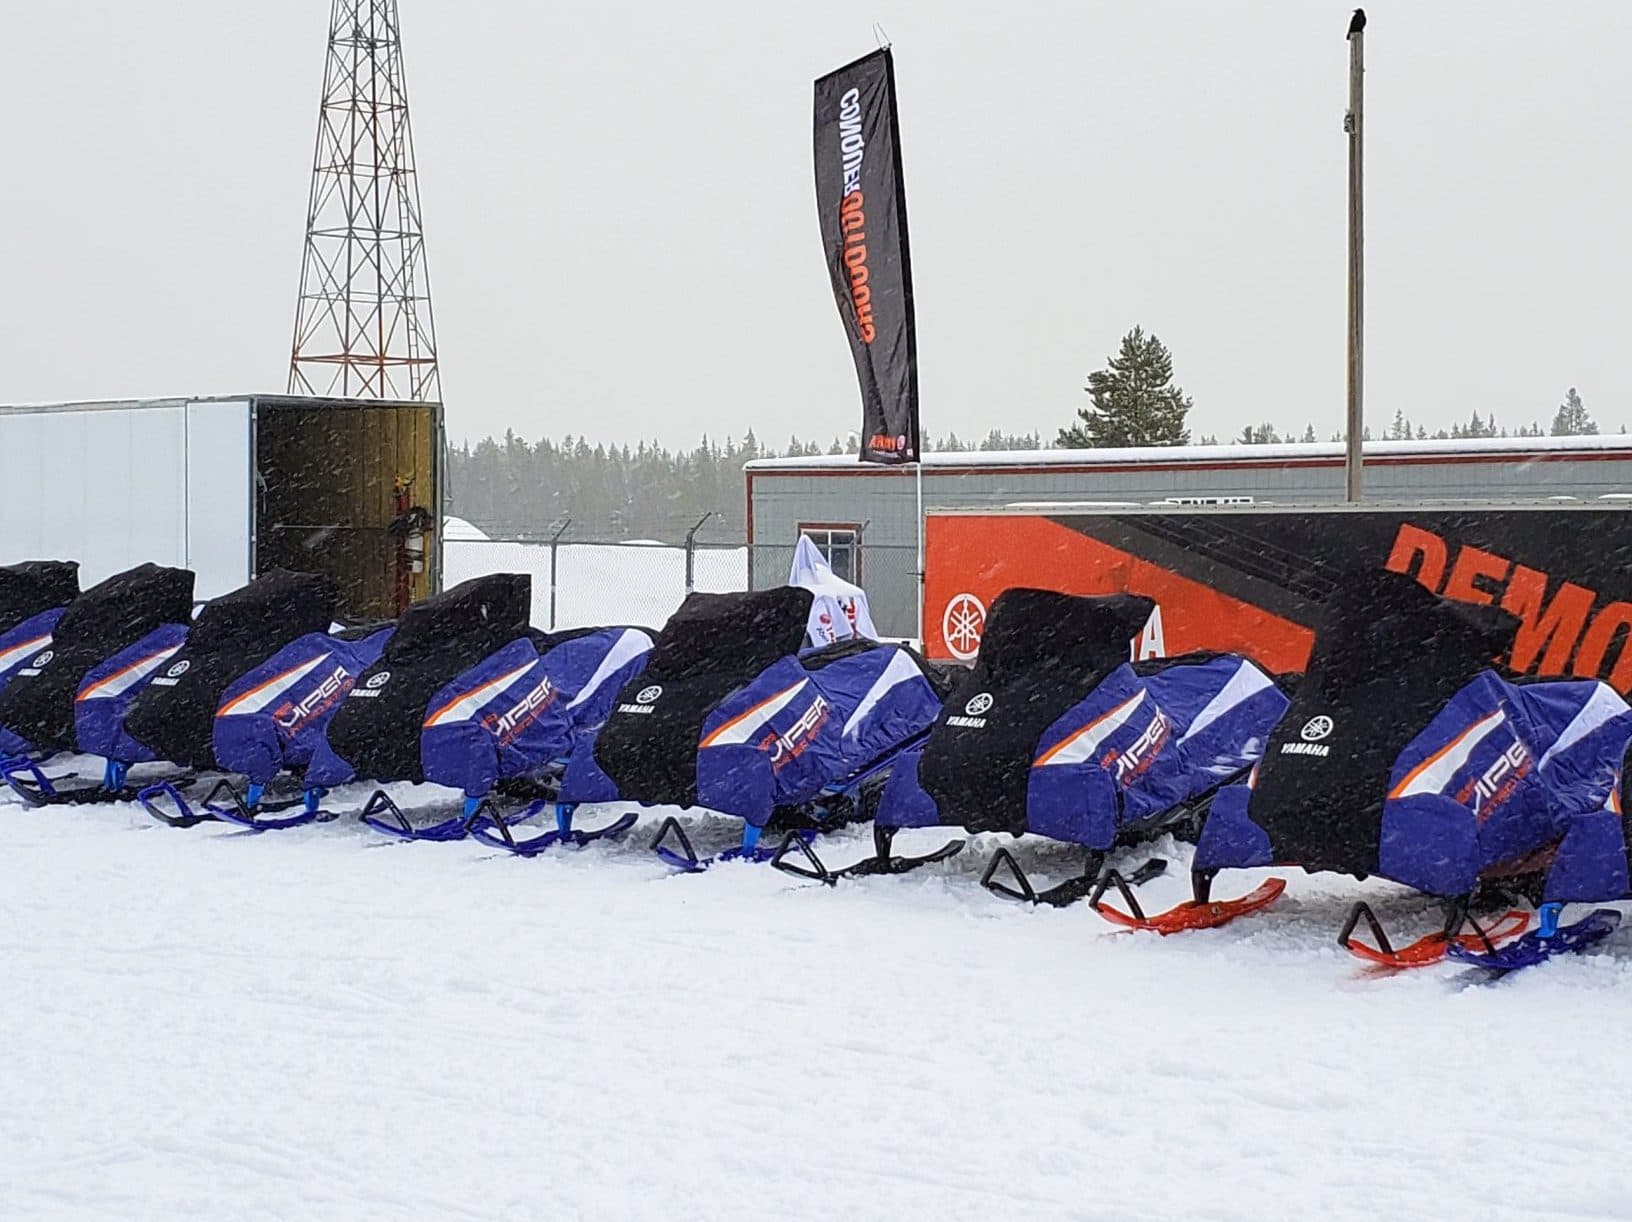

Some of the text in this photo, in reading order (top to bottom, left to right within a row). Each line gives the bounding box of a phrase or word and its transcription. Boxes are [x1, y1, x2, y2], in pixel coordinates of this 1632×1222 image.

[277, 665, 350, 727] VIPER
[617, 703, 656, 714] YAMAHA
[945, 715, 987, 729] YAMAHA
[1280, 742, 1330, 757] YAMAHA
